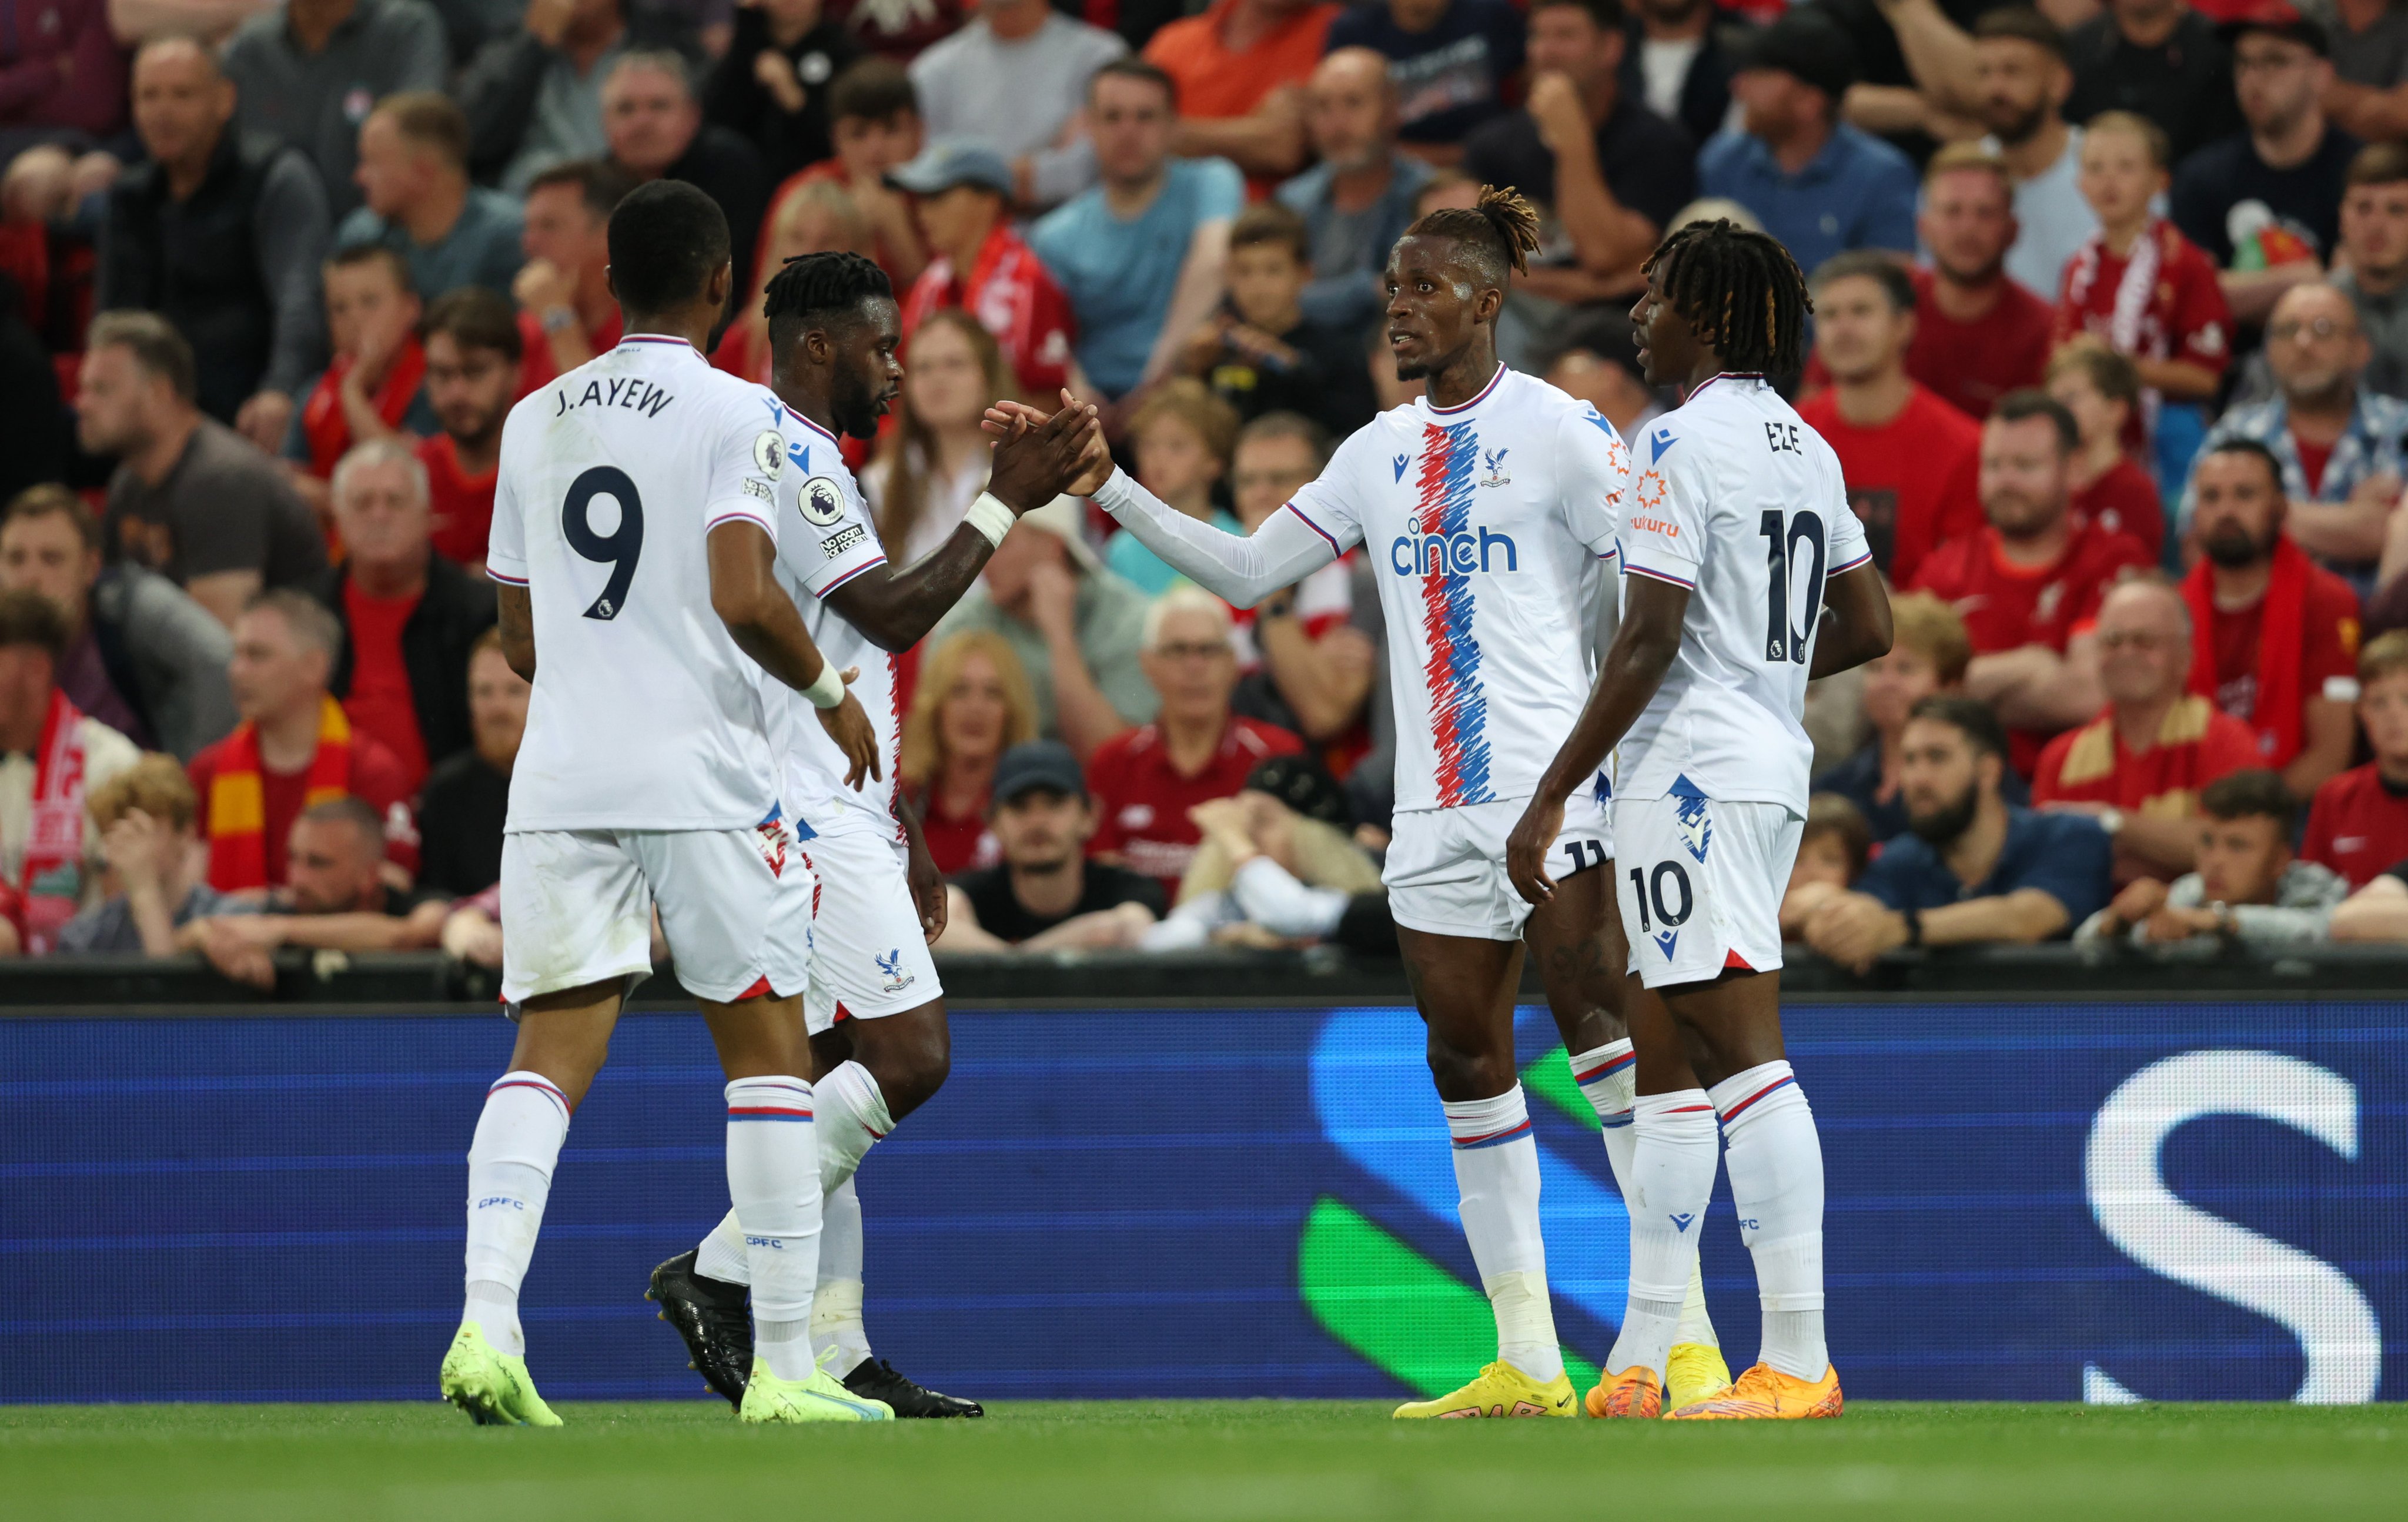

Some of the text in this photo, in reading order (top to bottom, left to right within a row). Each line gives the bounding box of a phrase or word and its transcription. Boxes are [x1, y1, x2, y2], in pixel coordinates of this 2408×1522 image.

[556, 378, 674, 418] J.AYEW
[1764, 422, 1802, 456] EZE
[561, 465, 644, 620] 9
[819, 527, 861, 553] No room
[1630, 515, 1679, 538] ukuru
[824, 533, 869, 560] for racism
[1391, 517, 1518, 577] cinch
[1759, 509, 1825, 665] 10
[1630, 859, 1694, 934] 10
[479, 1197, 524, 1210] CPFC
[745, 1237, 782, 1249] CPFC
[2083, 1049, 2382, 1404] S
